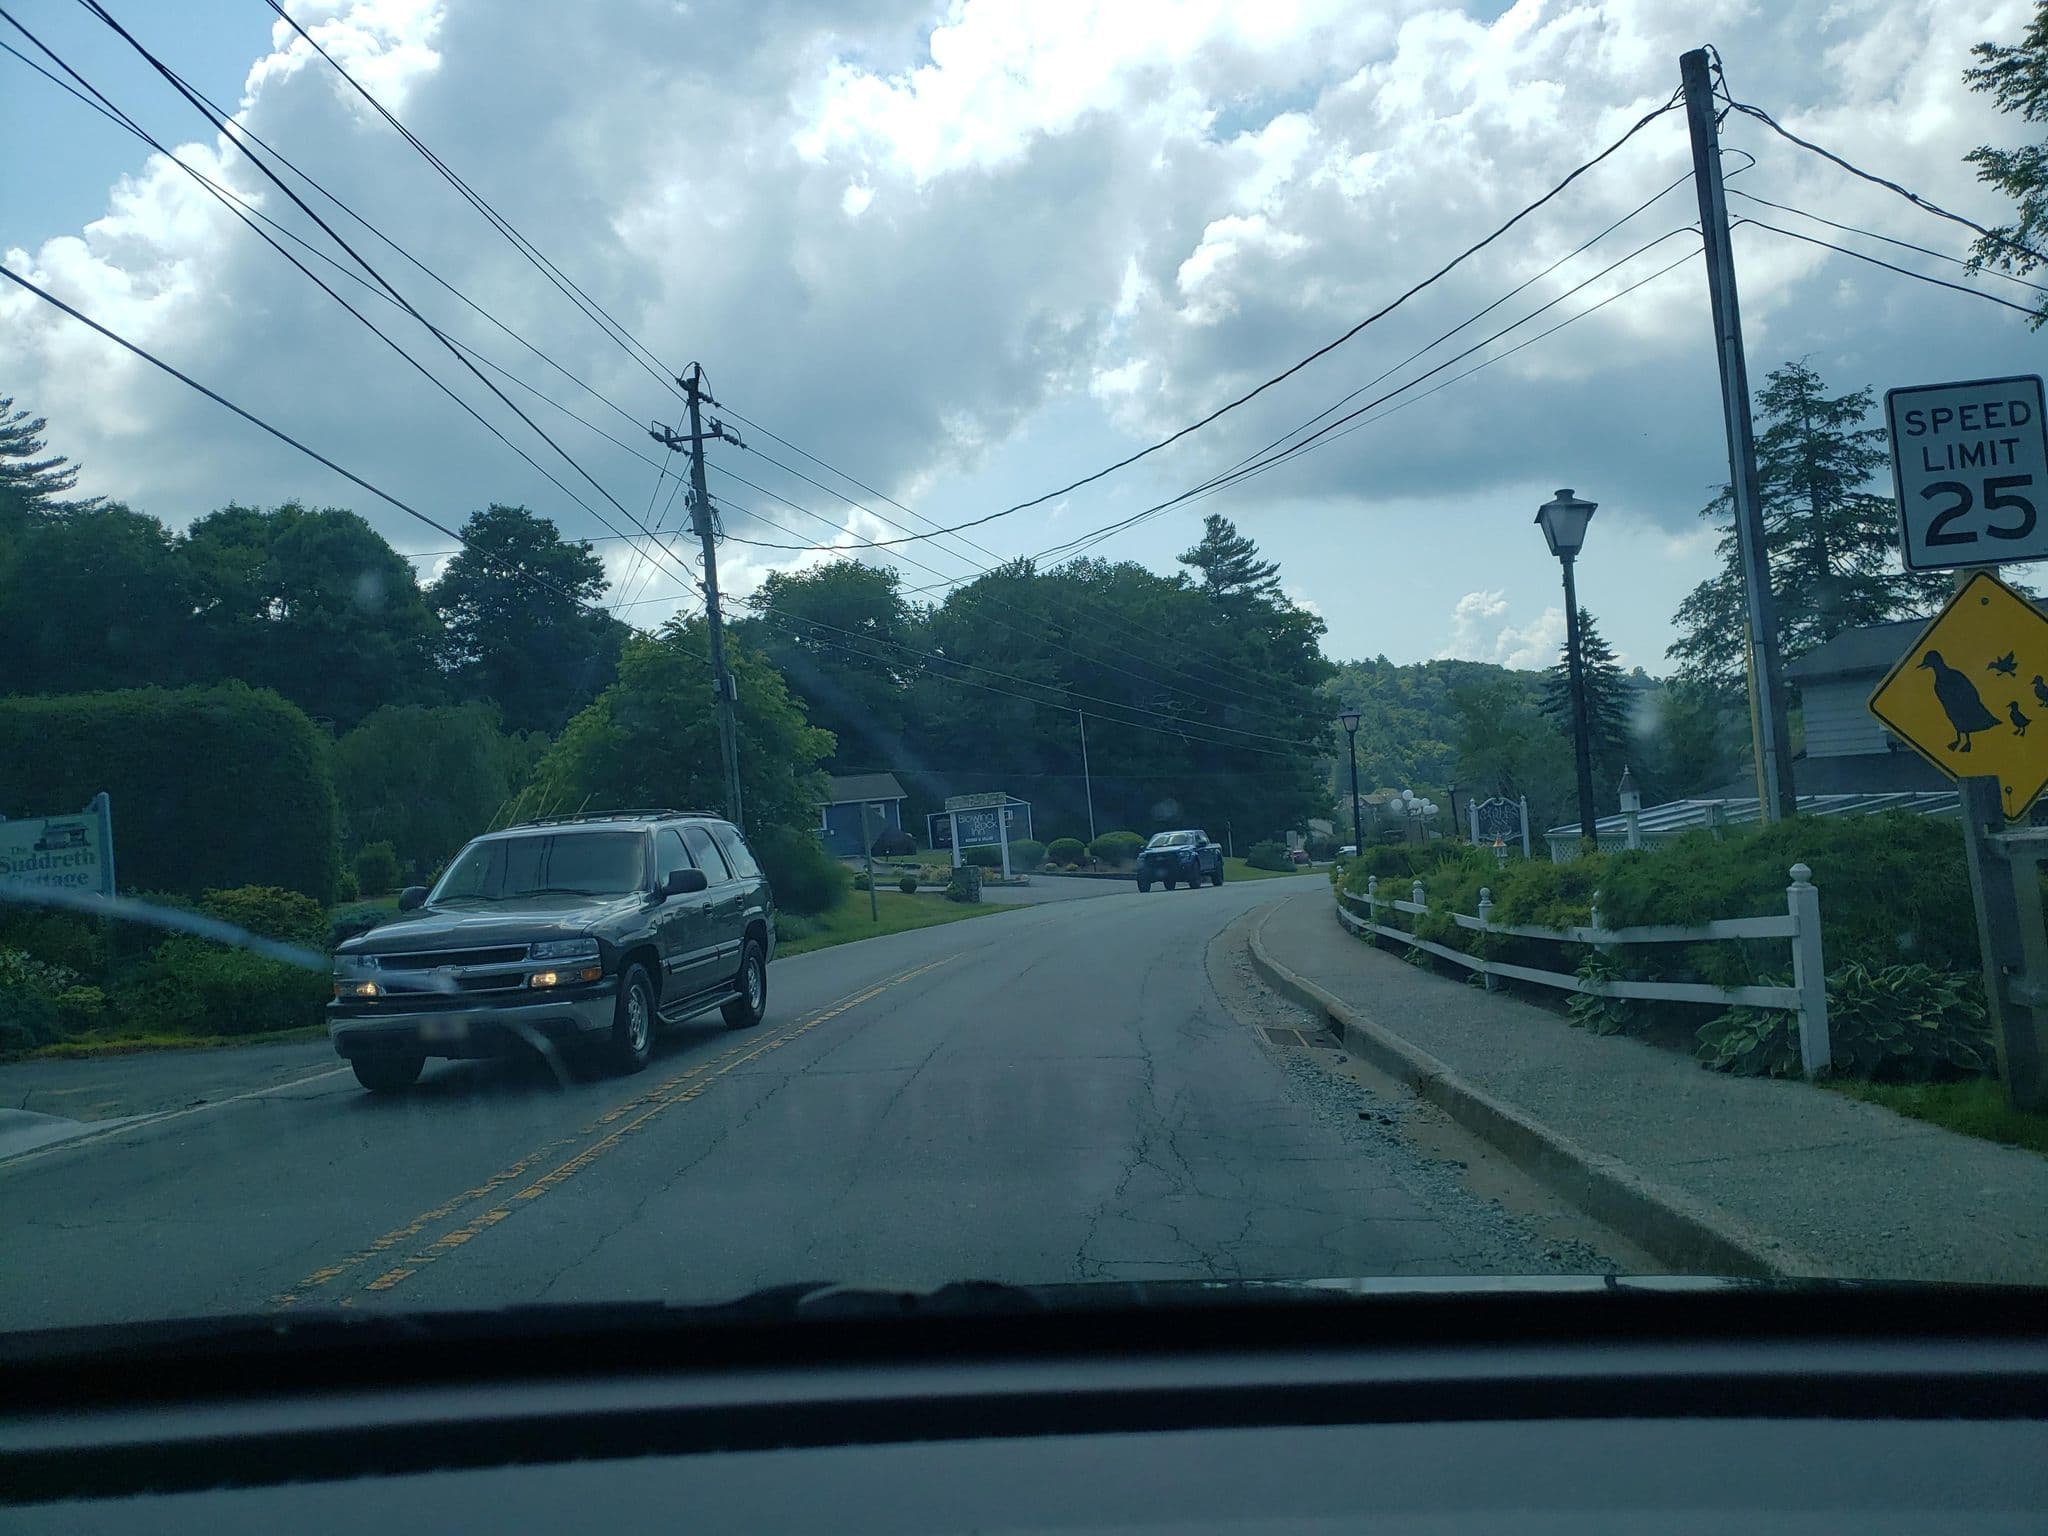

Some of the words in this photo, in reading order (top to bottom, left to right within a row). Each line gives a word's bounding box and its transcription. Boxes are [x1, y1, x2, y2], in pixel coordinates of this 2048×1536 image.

[1905, 400, 2031, 436] SPEED
[1922, 438, 2020, 472] LIMIT
[1920, 474, 2037, 547] 25
